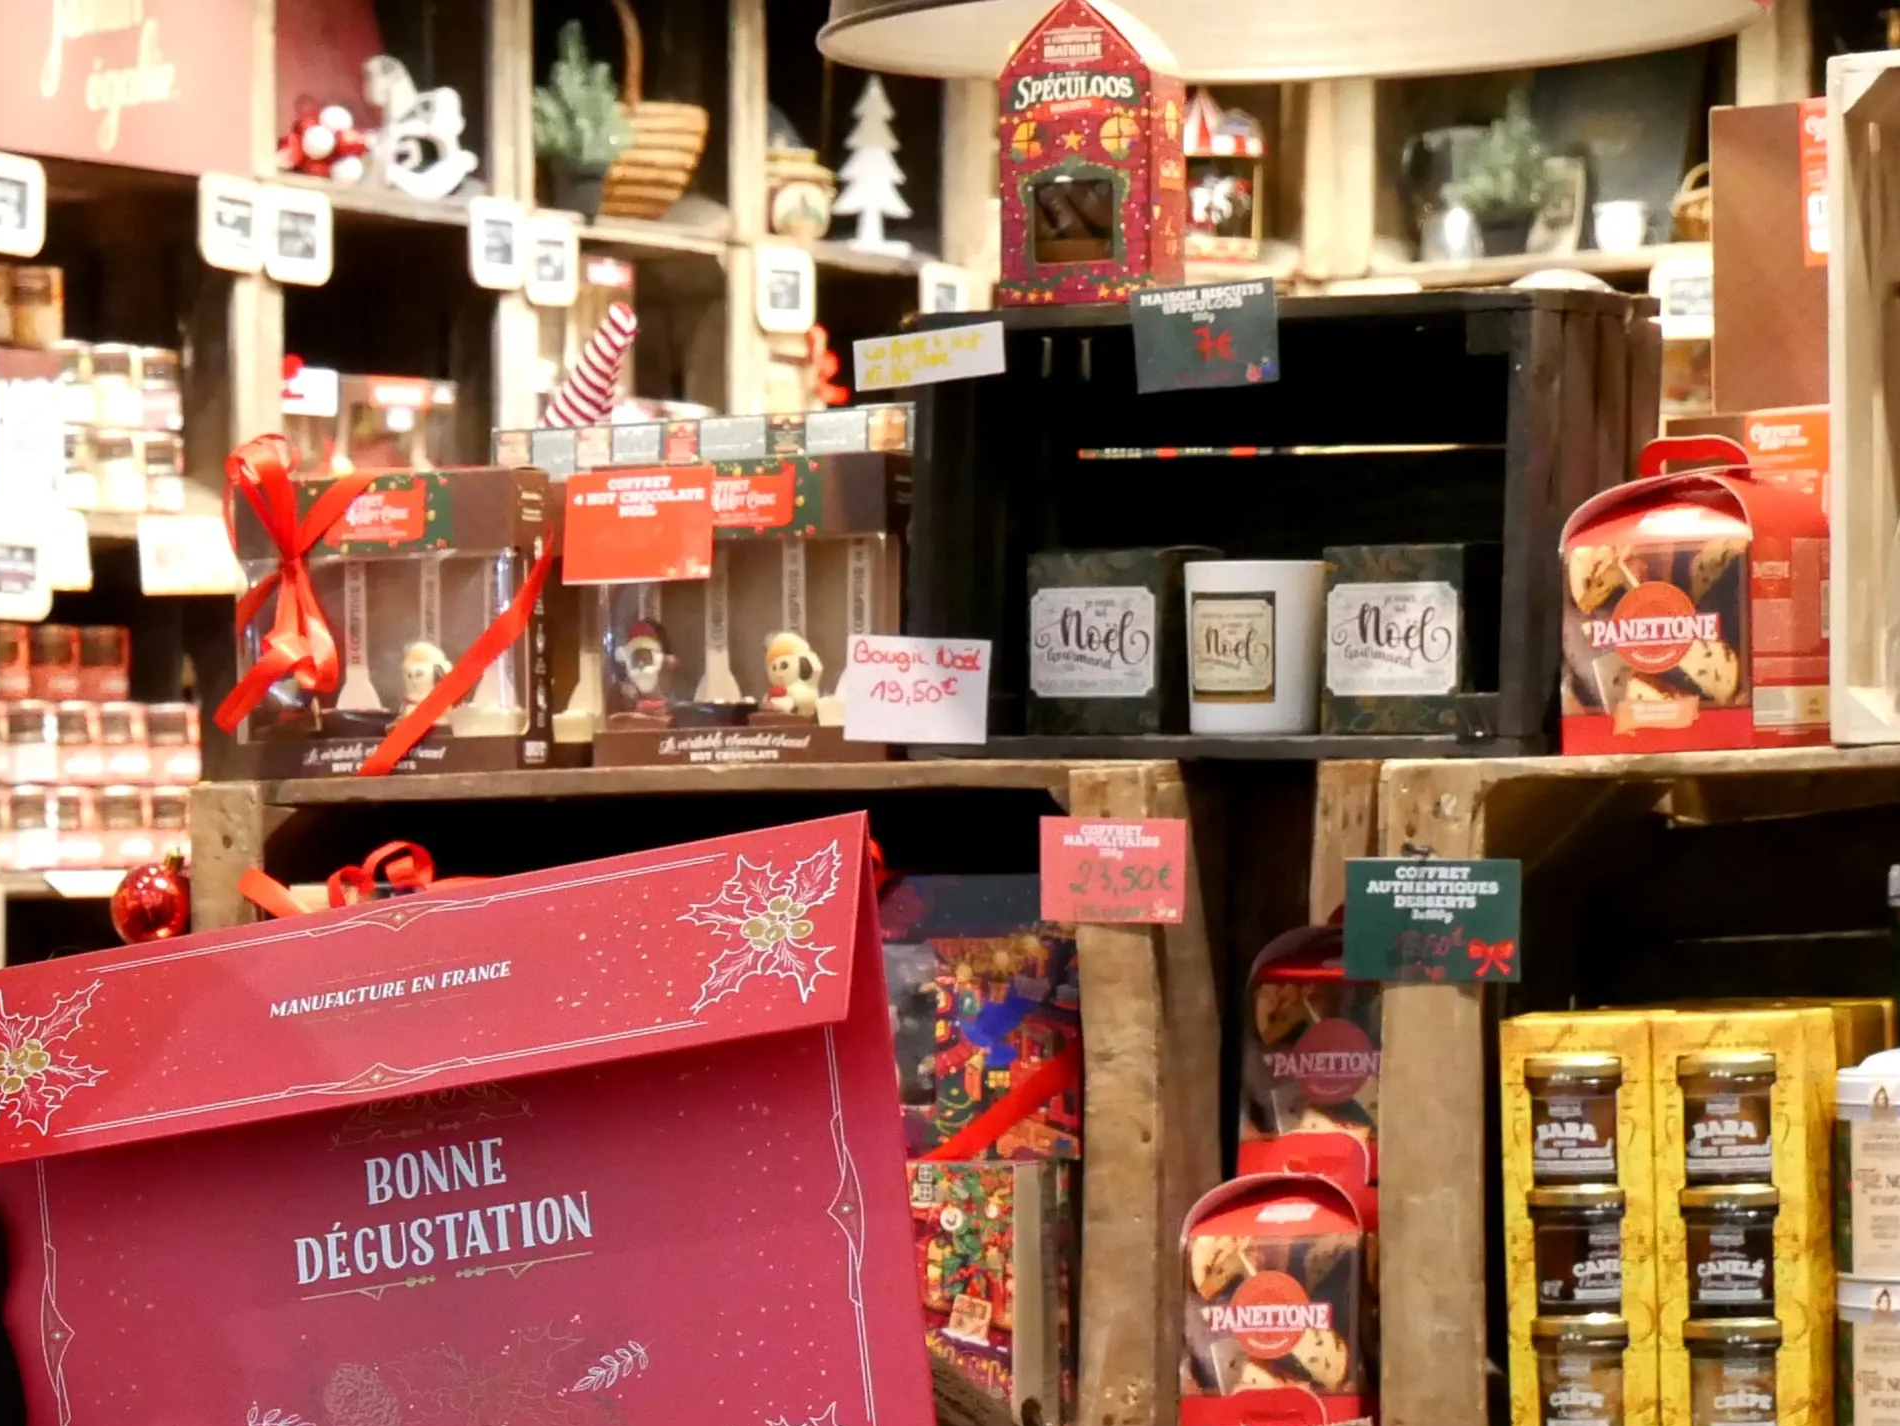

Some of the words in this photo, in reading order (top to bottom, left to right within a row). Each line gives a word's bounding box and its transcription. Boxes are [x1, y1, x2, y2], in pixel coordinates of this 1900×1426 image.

[1014, 72, 1134, 110] SPÉCULOOS
[1140, 289, 1197, 306] MAISON
[1200, 282, 1264, 299] BISCUITS
[586, 492, 616, 506] HOT
[619, 487, 705, 504] CHOCOLATE
[607, 475, 671, 491] COFFRET
[1034, 605, 1150, 666] Noël
[1332, 602, 1452, 663] Noël
[1592, 614, 1718, 647] PANETTONE
[870, 676, 958, 706] 19,50€
[1366, 880, 1500, 895] AUTHENTIQUES
[1395, 866, 1471, 880] COFFRET
[1393, 895, 1477, 909] DESSERTS
[269, 979, 406, 1019] MANUFACTURE
[411, 973, 436, 995] EN
[440, 960, 512, 988] FRANCE
[1273, 1050, 1381, 1078] PANETTON
[364, 1137, 507, 1205] BONNE
[295, 1191, 593, 1285] DÉGUSTATION
[1210, 1304, 1331, 1332] PANETTONE
